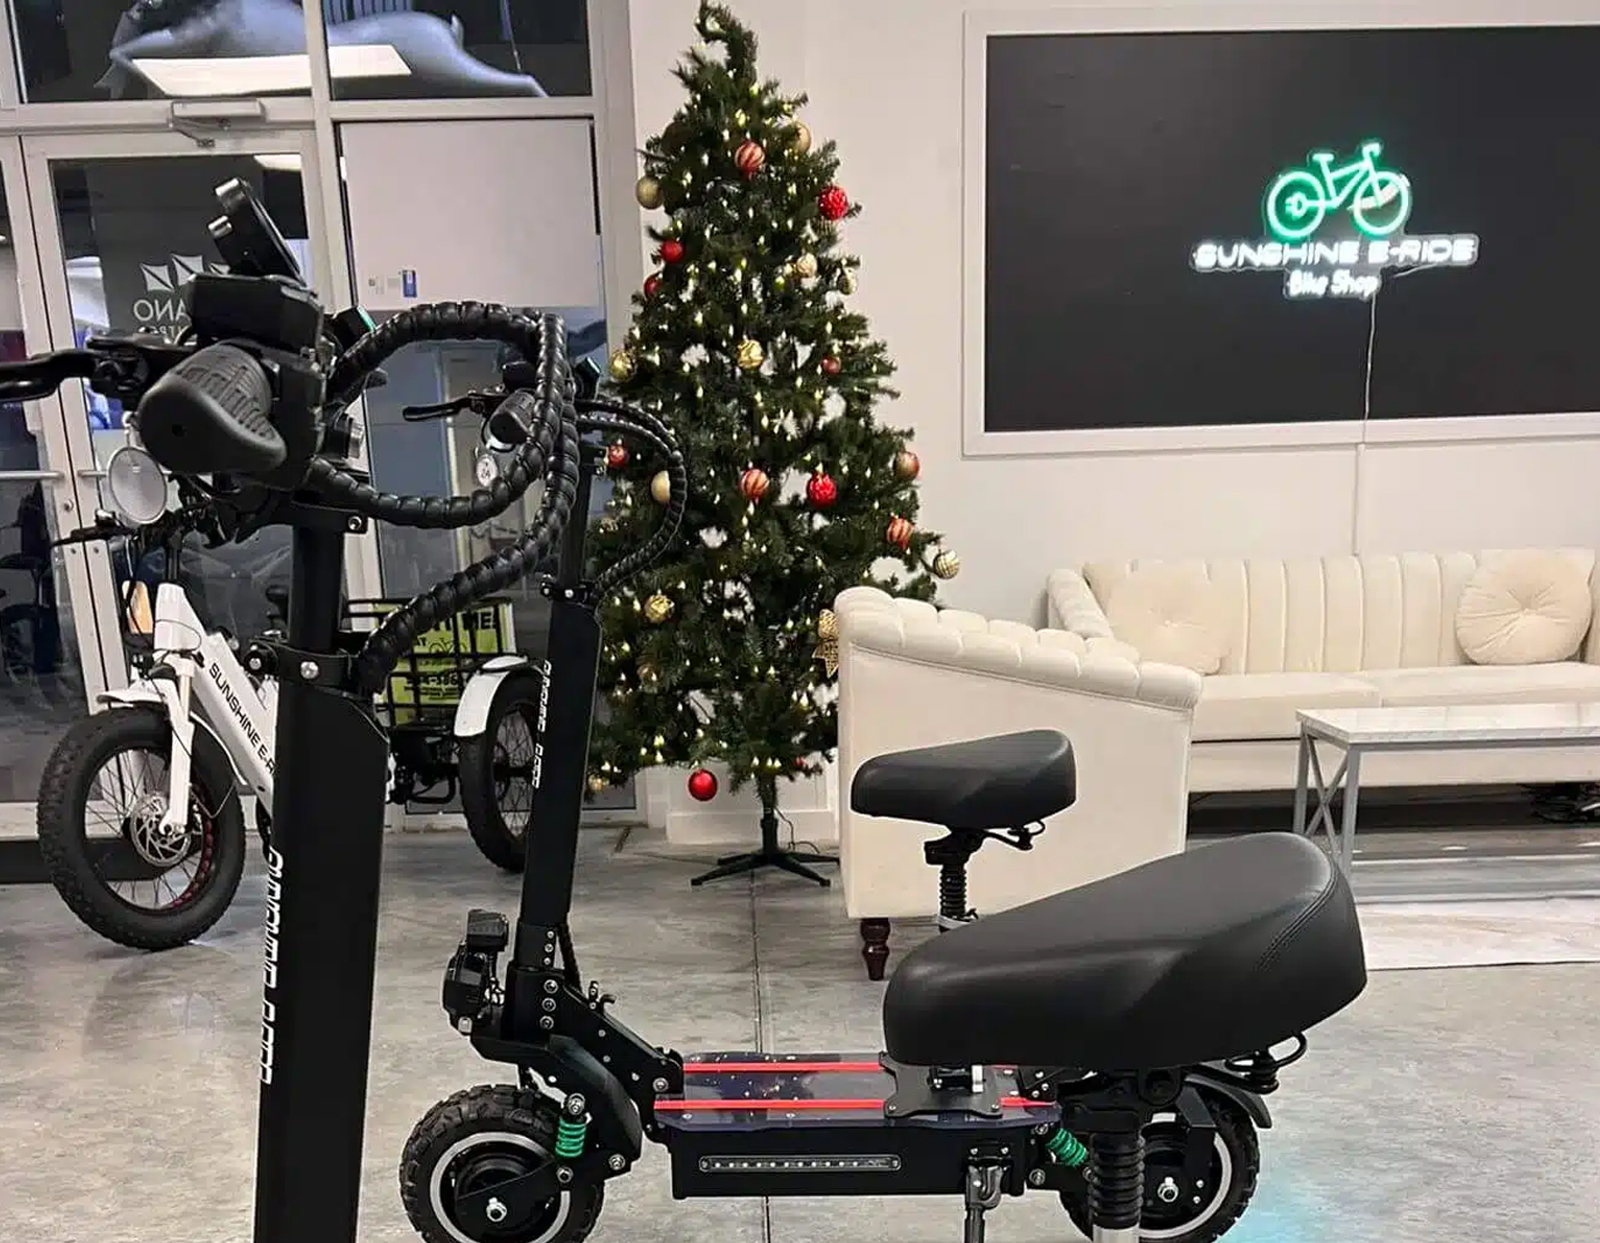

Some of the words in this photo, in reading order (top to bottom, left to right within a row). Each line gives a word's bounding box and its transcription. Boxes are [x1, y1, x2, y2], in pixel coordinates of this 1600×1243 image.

[1194, 241, 1360, 267] SUNSHINE
[1367, 239, 1475, 264] E-RIDE
[1289, 269, 1329, 297] Bike
[1330, 269, 1379, 297] Shop
[209, 662, 261, 748] SUNSHINE
